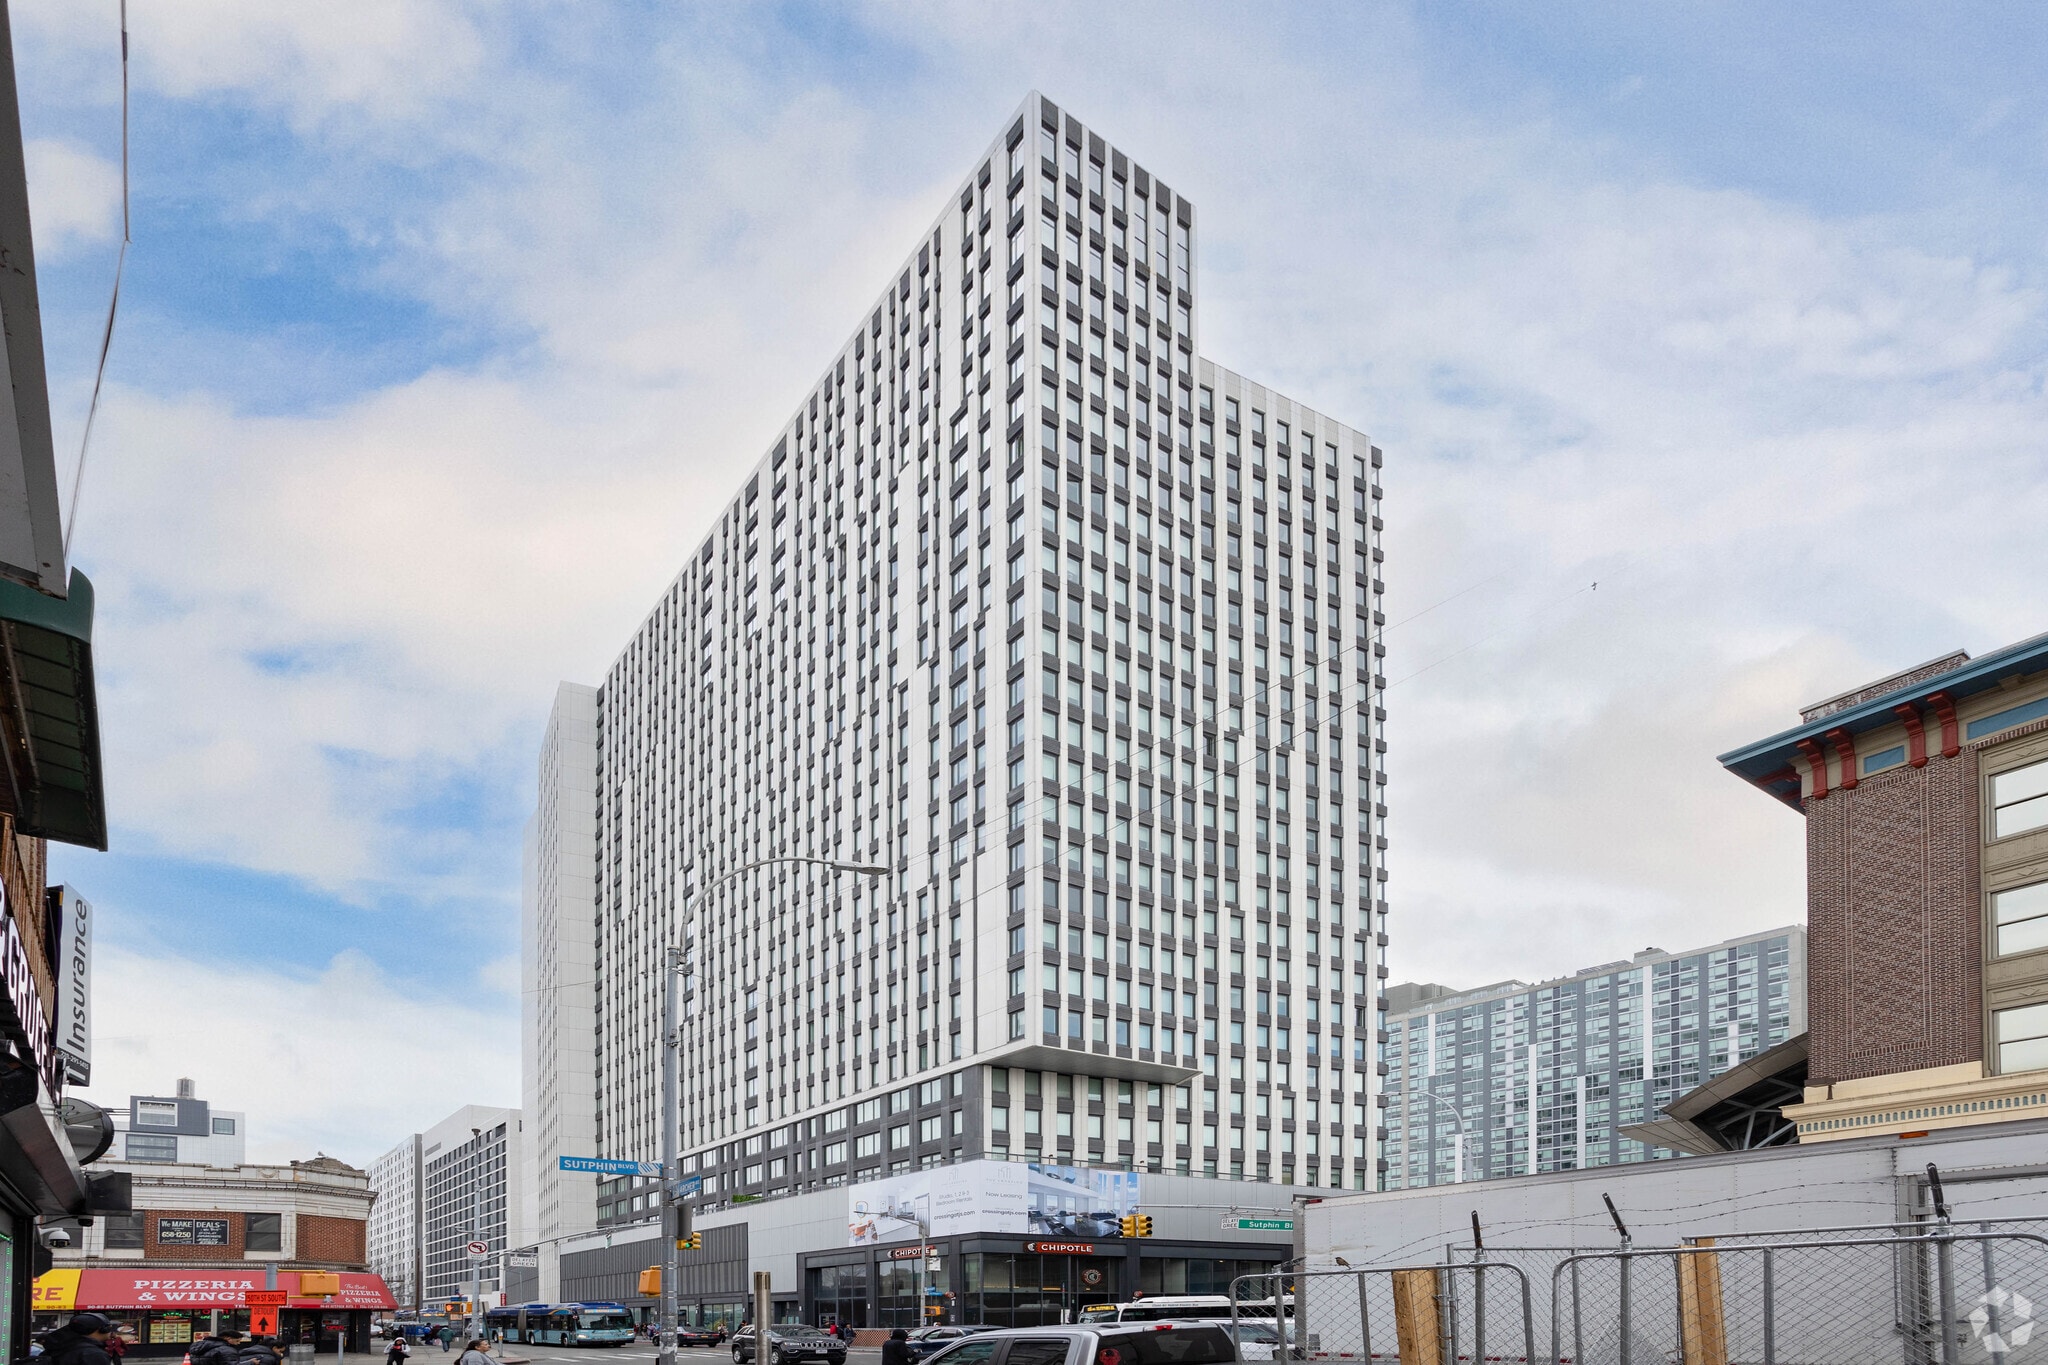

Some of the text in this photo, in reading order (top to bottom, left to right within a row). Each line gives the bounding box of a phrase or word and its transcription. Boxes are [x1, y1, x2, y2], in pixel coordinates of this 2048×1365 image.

[67, 899, 87, 1053] Insurance
[564, 1159, 617, 1171] SUTPHIN
[1249, 1221, 1280, 1229] Sutphin
[895, 1247, 930, 1257] CHIPOTE
[1041, 1244, 1092, 1252] CHIPOTLE
[133, 1280, 254, 1290] PIZZERIA
[138, 1292, 246, 1301] & WINGS
[261, 1294, 267, 1302] ST
[268, 1294, 285, 1302] SOUTH
[254, 1307, 275, 1315] DETOUR
